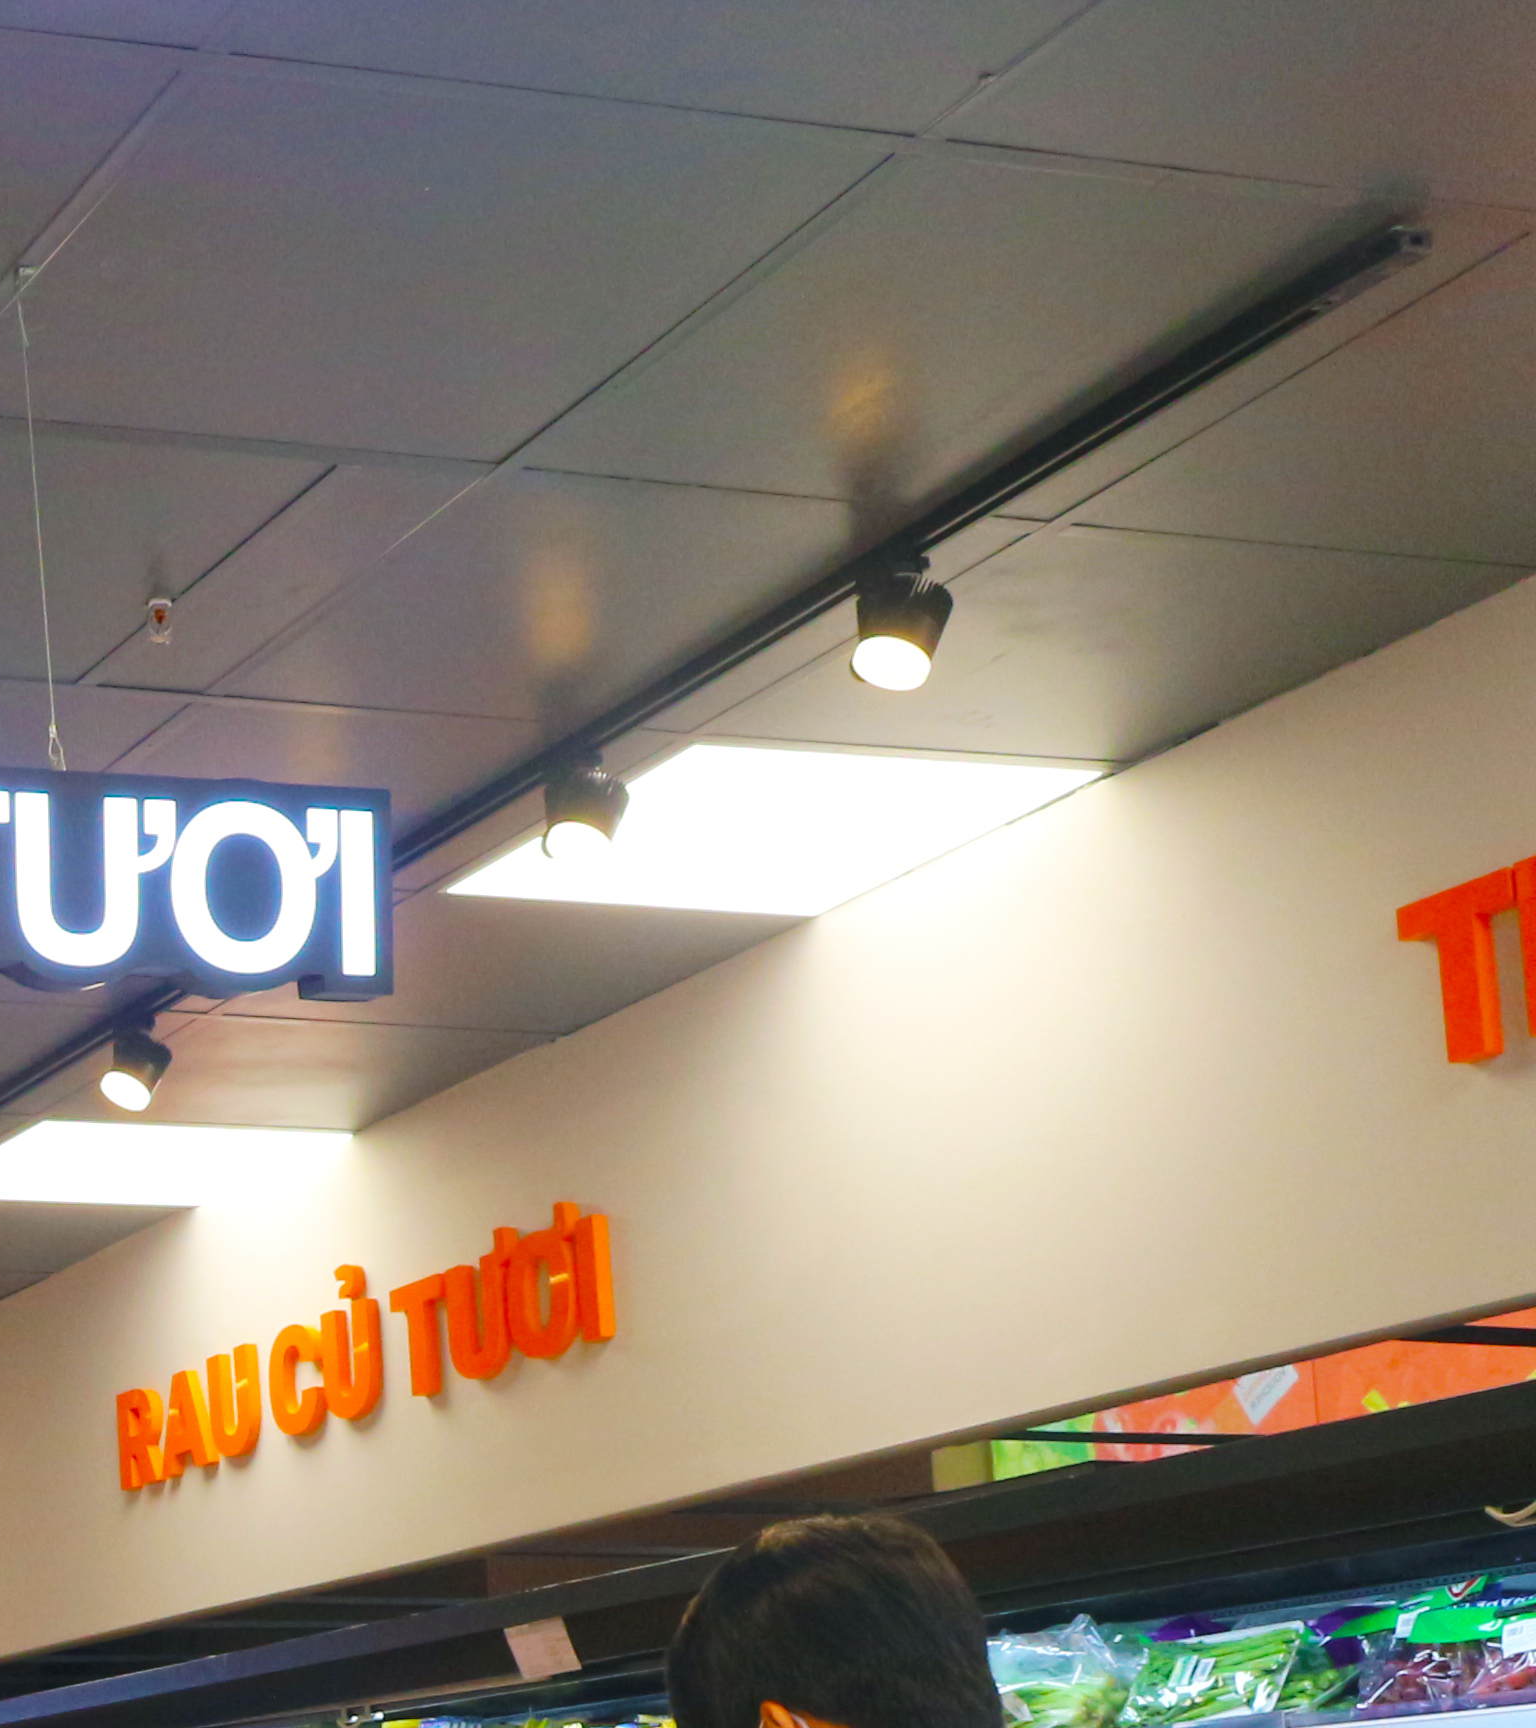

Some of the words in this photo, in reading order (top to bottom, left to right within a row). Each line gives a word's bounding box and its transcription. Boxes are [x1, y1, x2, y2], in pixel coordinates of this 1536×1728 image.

[116, 1343, 262, 1491] RAU
[269, 1264, 382, 1436] CỦ
[389, 1201, 616, 1398] TƯƠI
